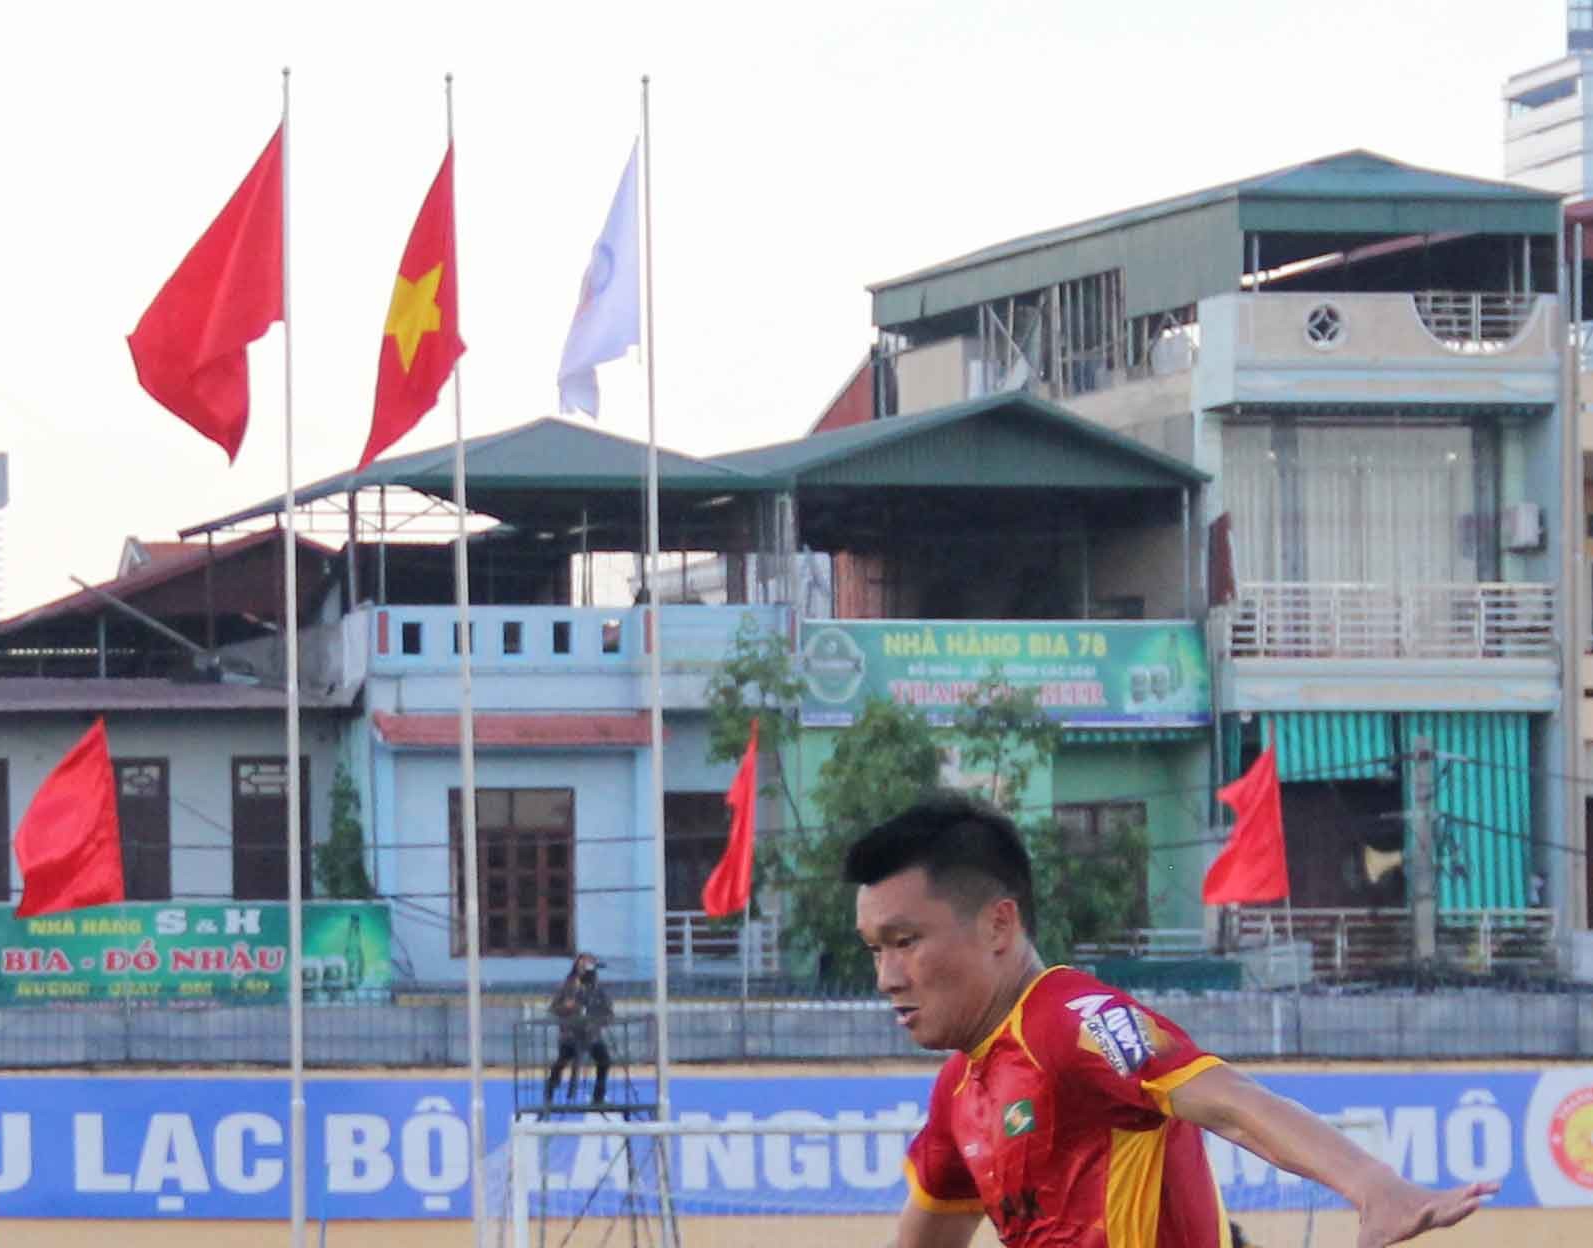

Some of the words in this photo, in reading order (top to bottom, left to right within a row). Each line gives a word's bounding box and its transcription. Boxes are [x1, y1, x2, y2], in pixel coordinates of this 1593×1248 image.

[224, 908, 262, 935] H
[1, 947, 73, 974] BIA
[73, 1112, 285, 1211] LẠC
[325, 1096, 470, 1211] BỘ
